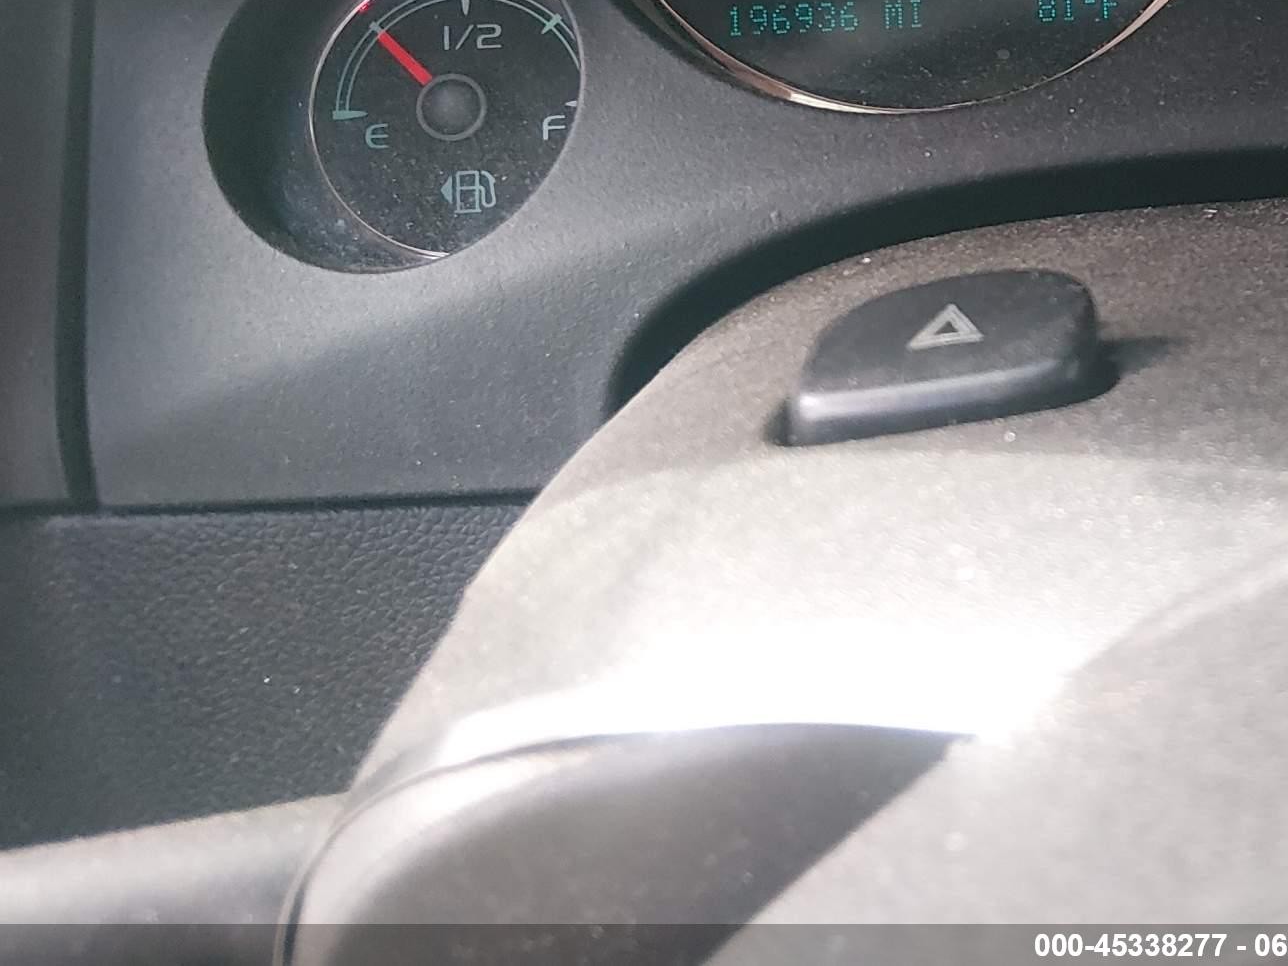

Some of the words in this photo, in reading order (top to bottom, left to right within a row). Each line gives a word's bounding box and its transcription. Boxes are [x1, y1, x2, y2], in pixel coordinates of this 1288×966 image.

[728, 0, 860, 36] 196936
[443, 23, 502, 51] 1/2
[365, 123, 390, 149] E
[542, 115, 566, 141] F
